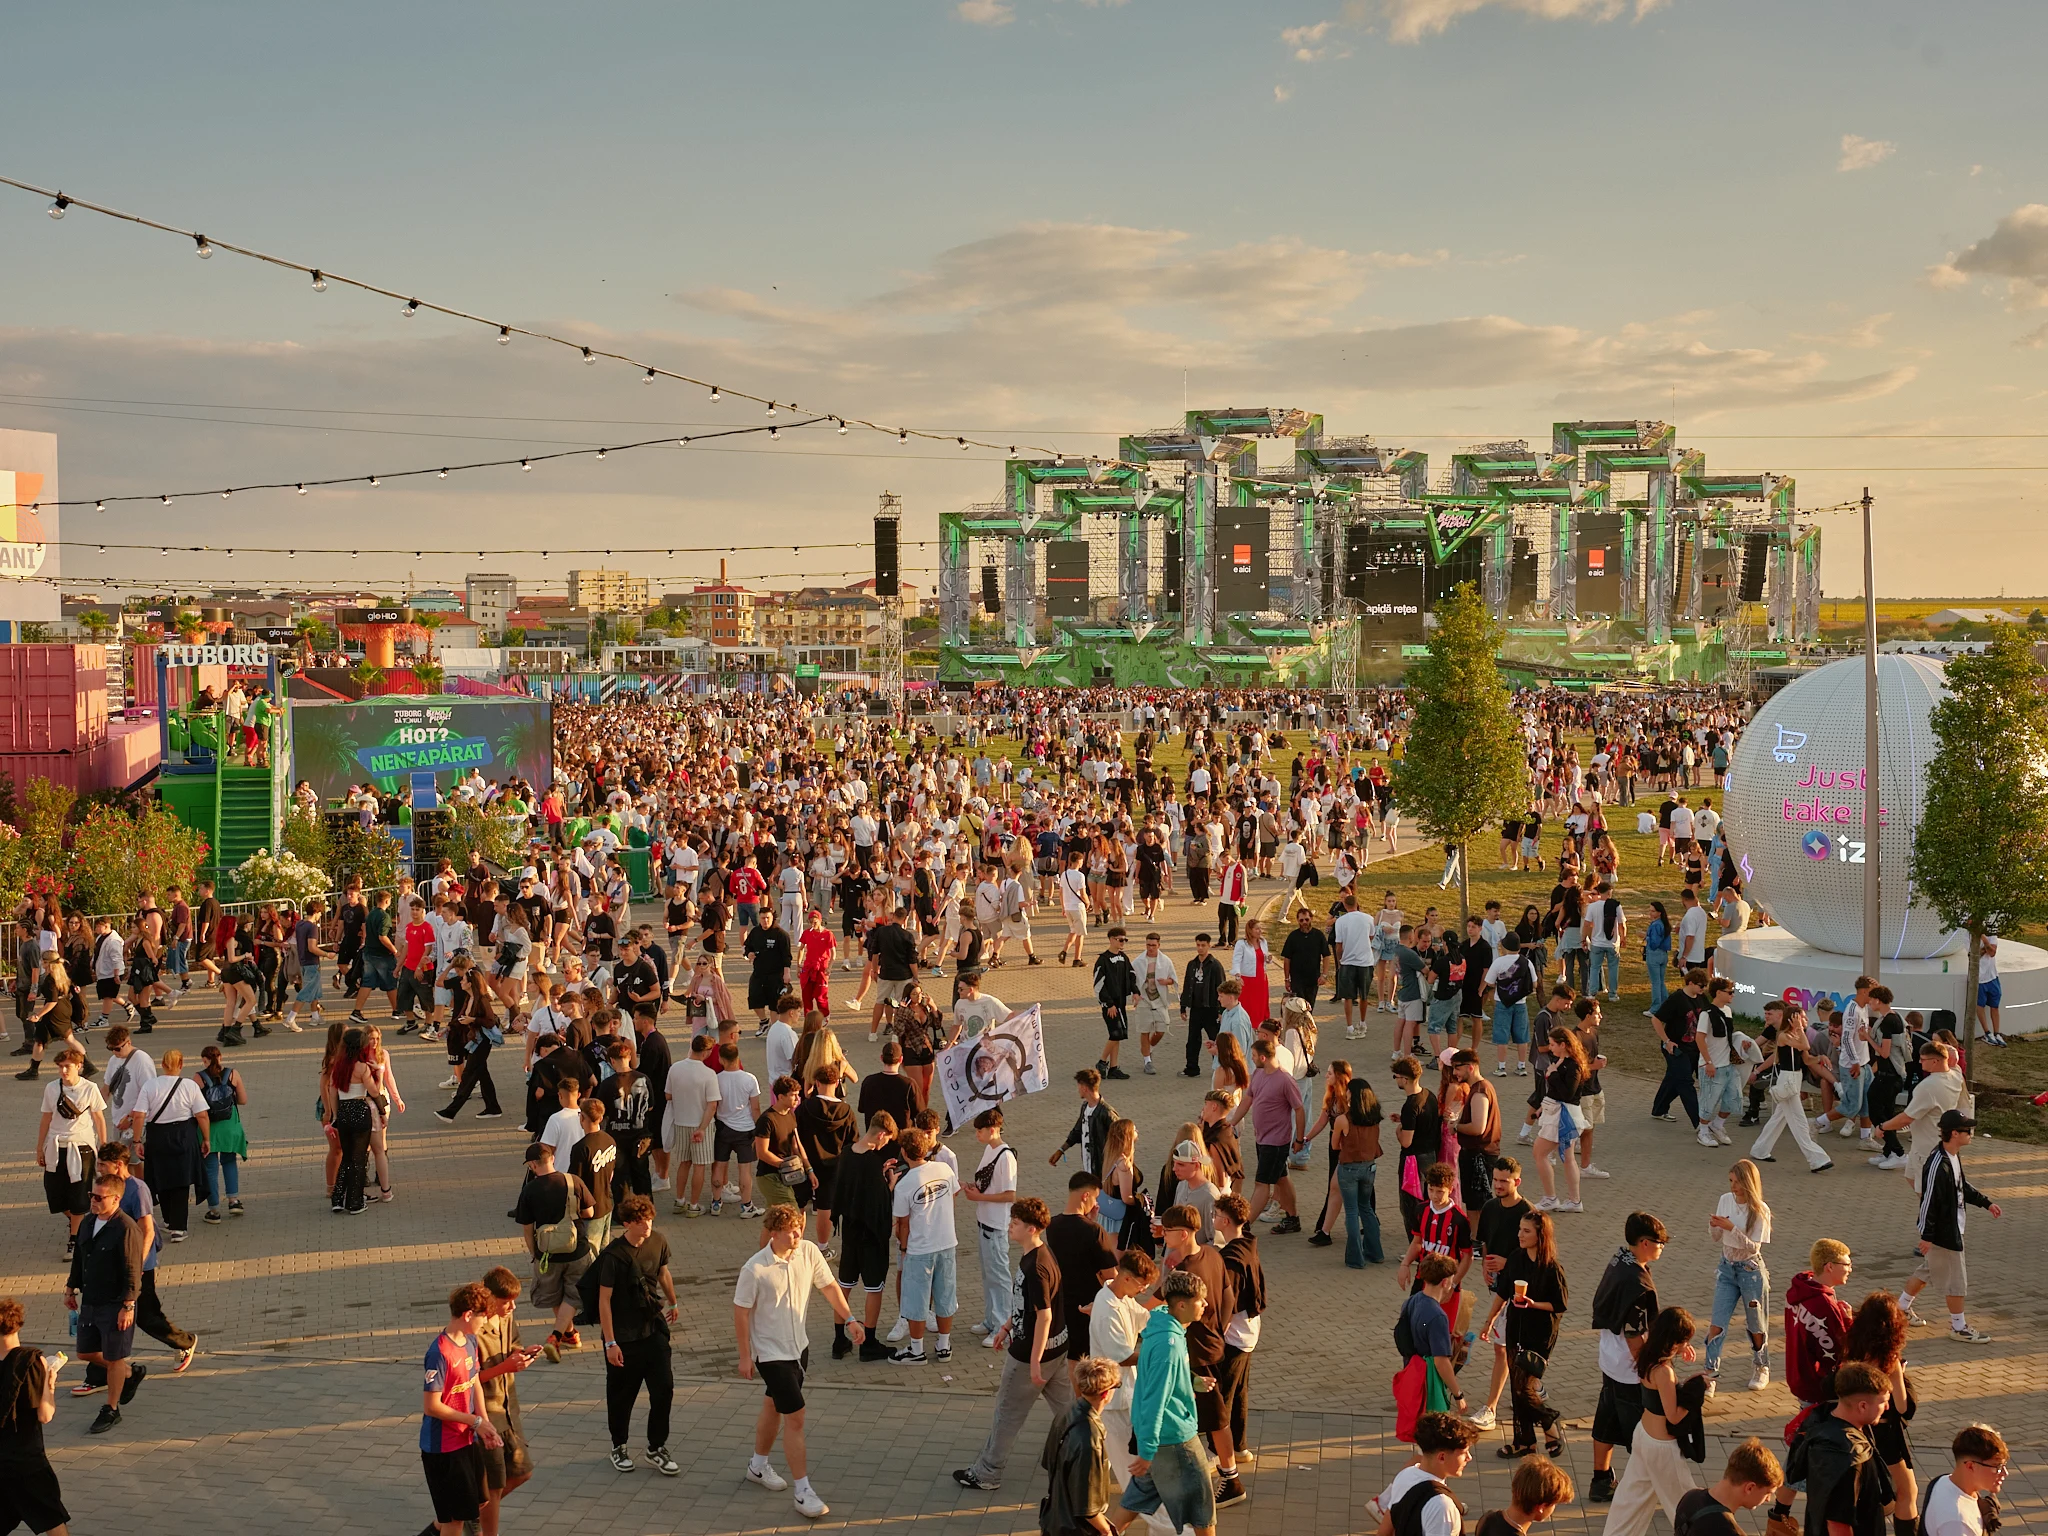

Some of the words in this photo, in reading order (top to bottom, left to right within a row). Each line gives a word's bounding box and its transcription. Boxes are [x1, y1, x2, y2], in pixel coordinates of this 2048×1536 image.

[367, 612, 381, 621] glo
[269, 629, 280, 638] glo
[161, 643, 269, 668] TUBORG
[393, 709, 422, 718] TUBORG
[400, 727, 449, 744] HOT?
[1782, 796, 1852, 825] take
[739, 878, 748, 895] 8
